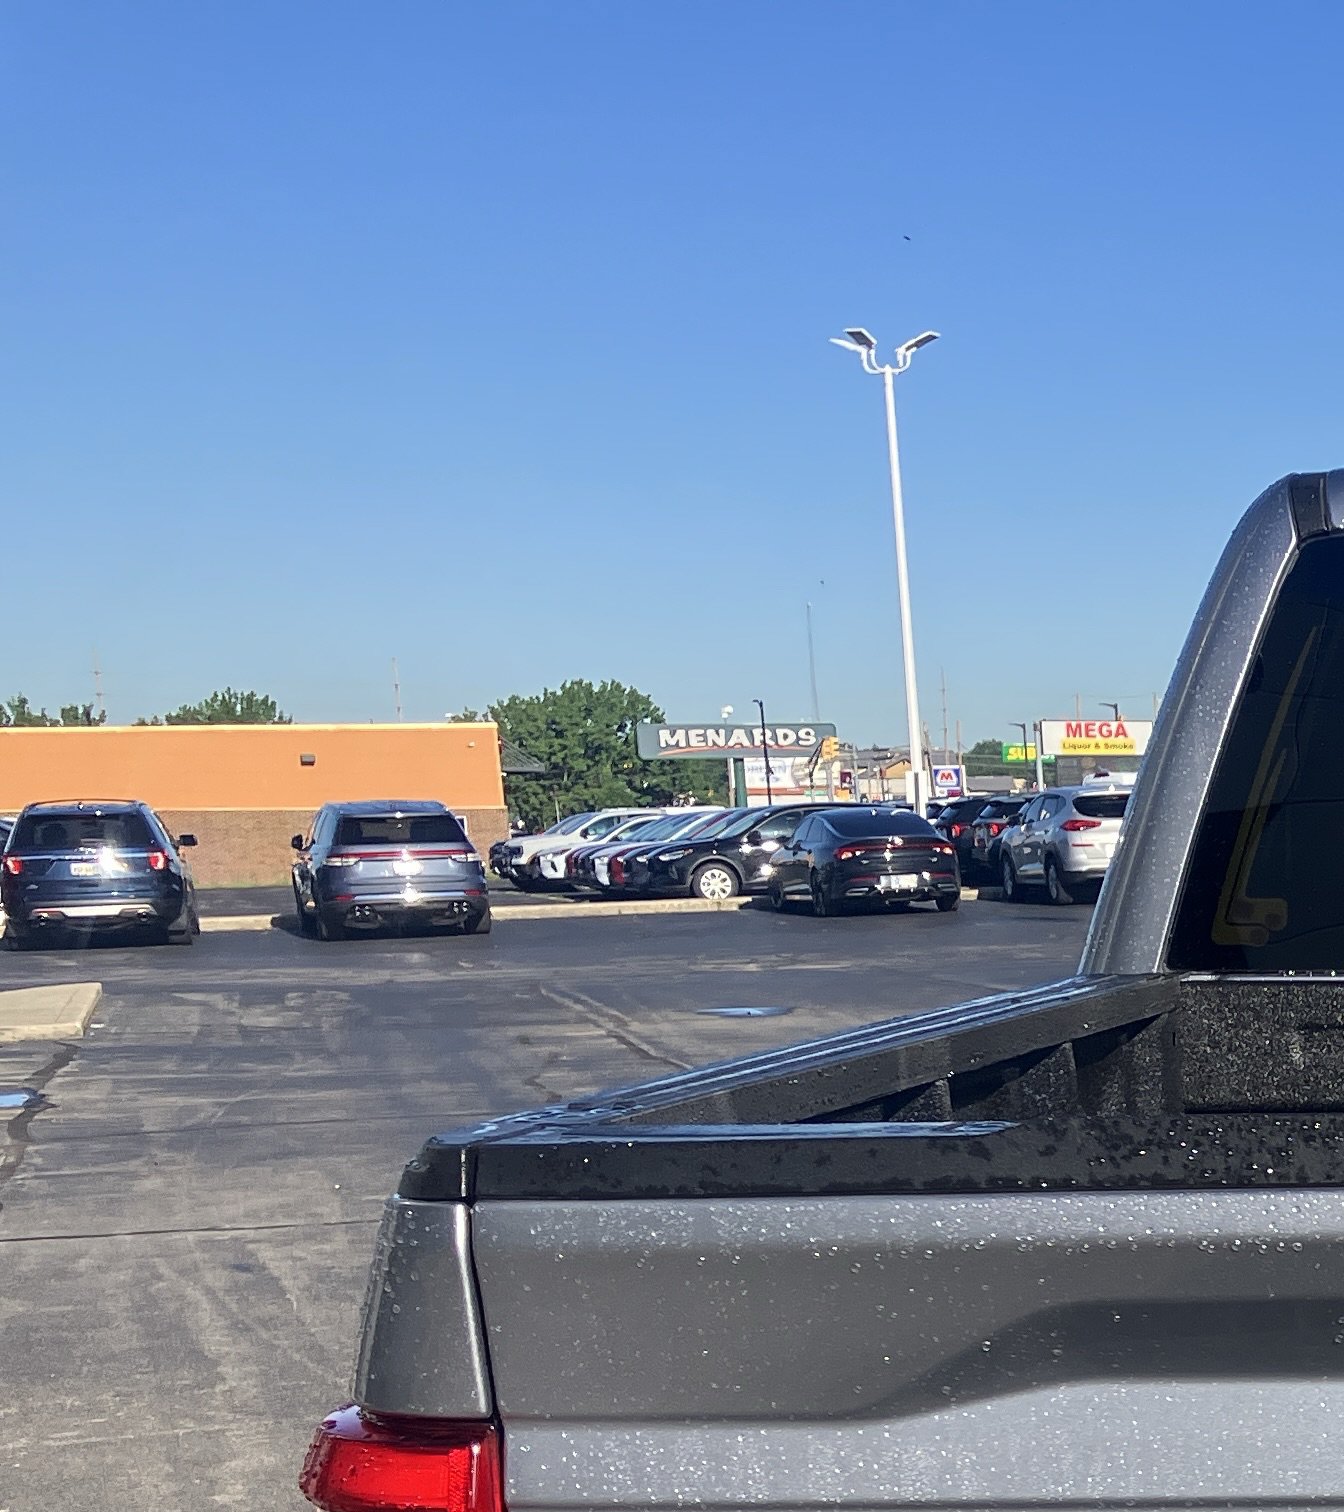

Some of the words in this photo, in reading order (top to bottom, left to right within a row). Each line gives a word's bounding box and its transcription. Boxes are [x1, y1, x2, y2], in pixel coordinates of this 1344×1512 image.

[658, 727, 817, 749] MENARDS
[1065, 720, 1129, 738] MEGA
[1063, 742, 1091, 750] Liquor
